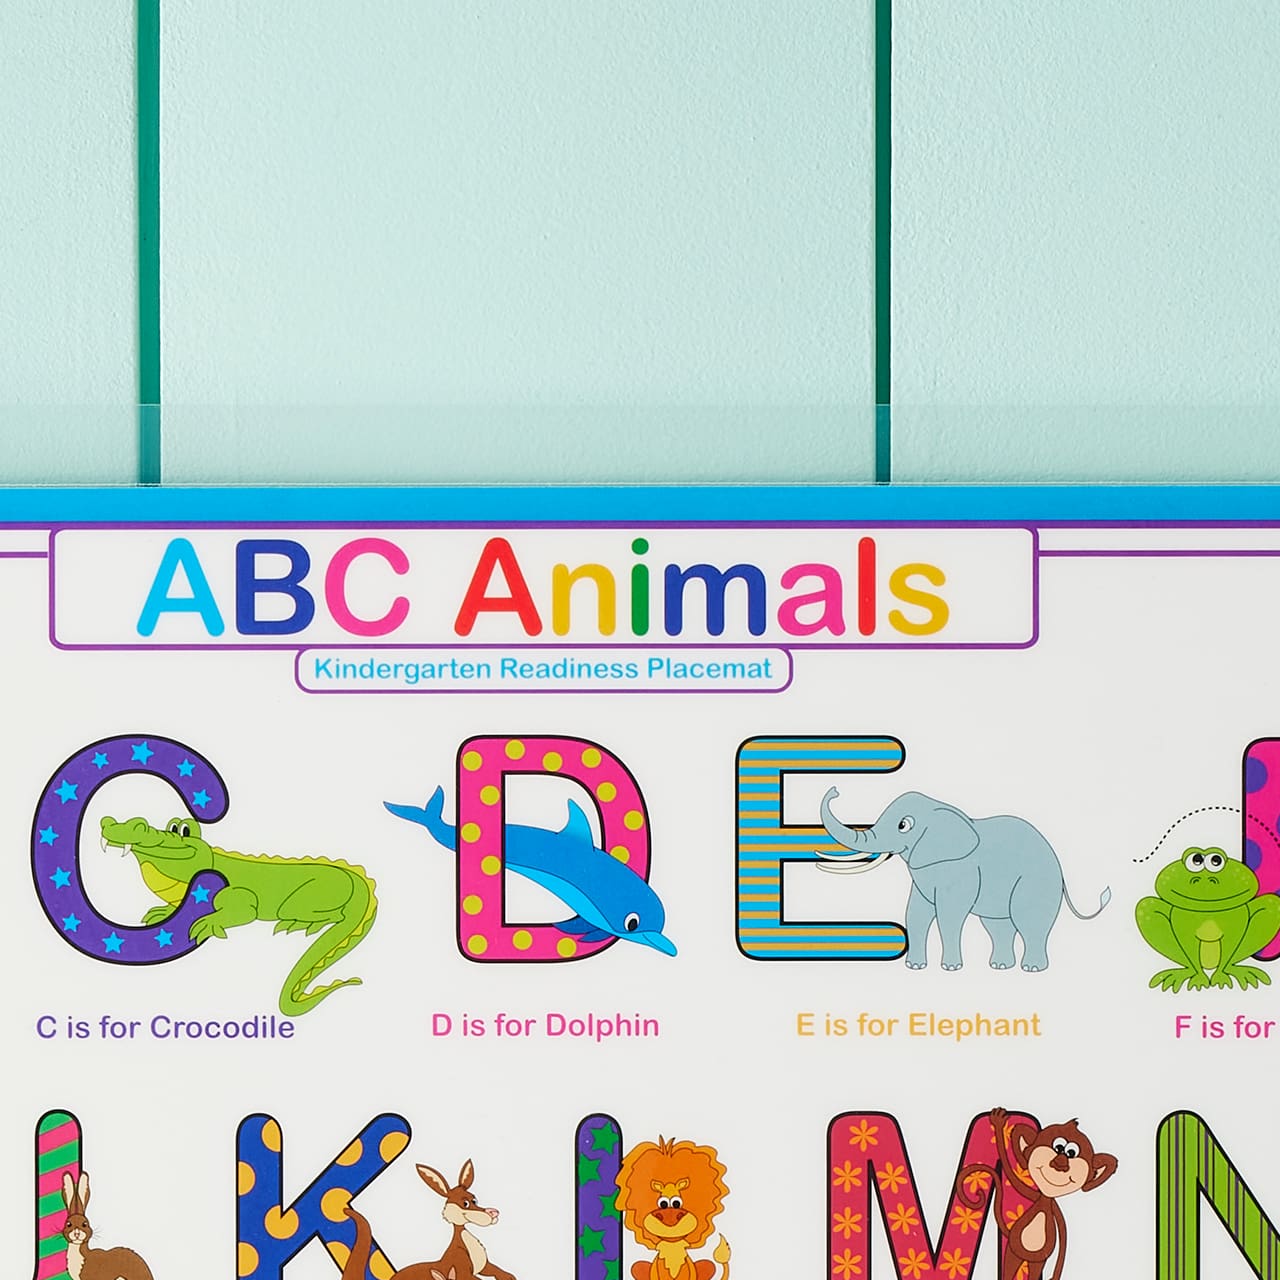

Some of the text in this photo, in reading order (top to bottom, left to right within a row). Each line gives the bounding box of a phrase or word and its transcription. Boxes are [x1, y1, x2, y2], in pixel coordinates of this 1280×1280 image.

[136, 537, 950, 637] ABC Animals
[315, 657, 772, 684] Kindergarten Readiness Placemat
[37, 1015, 296, 1039] C is for Crocodile
